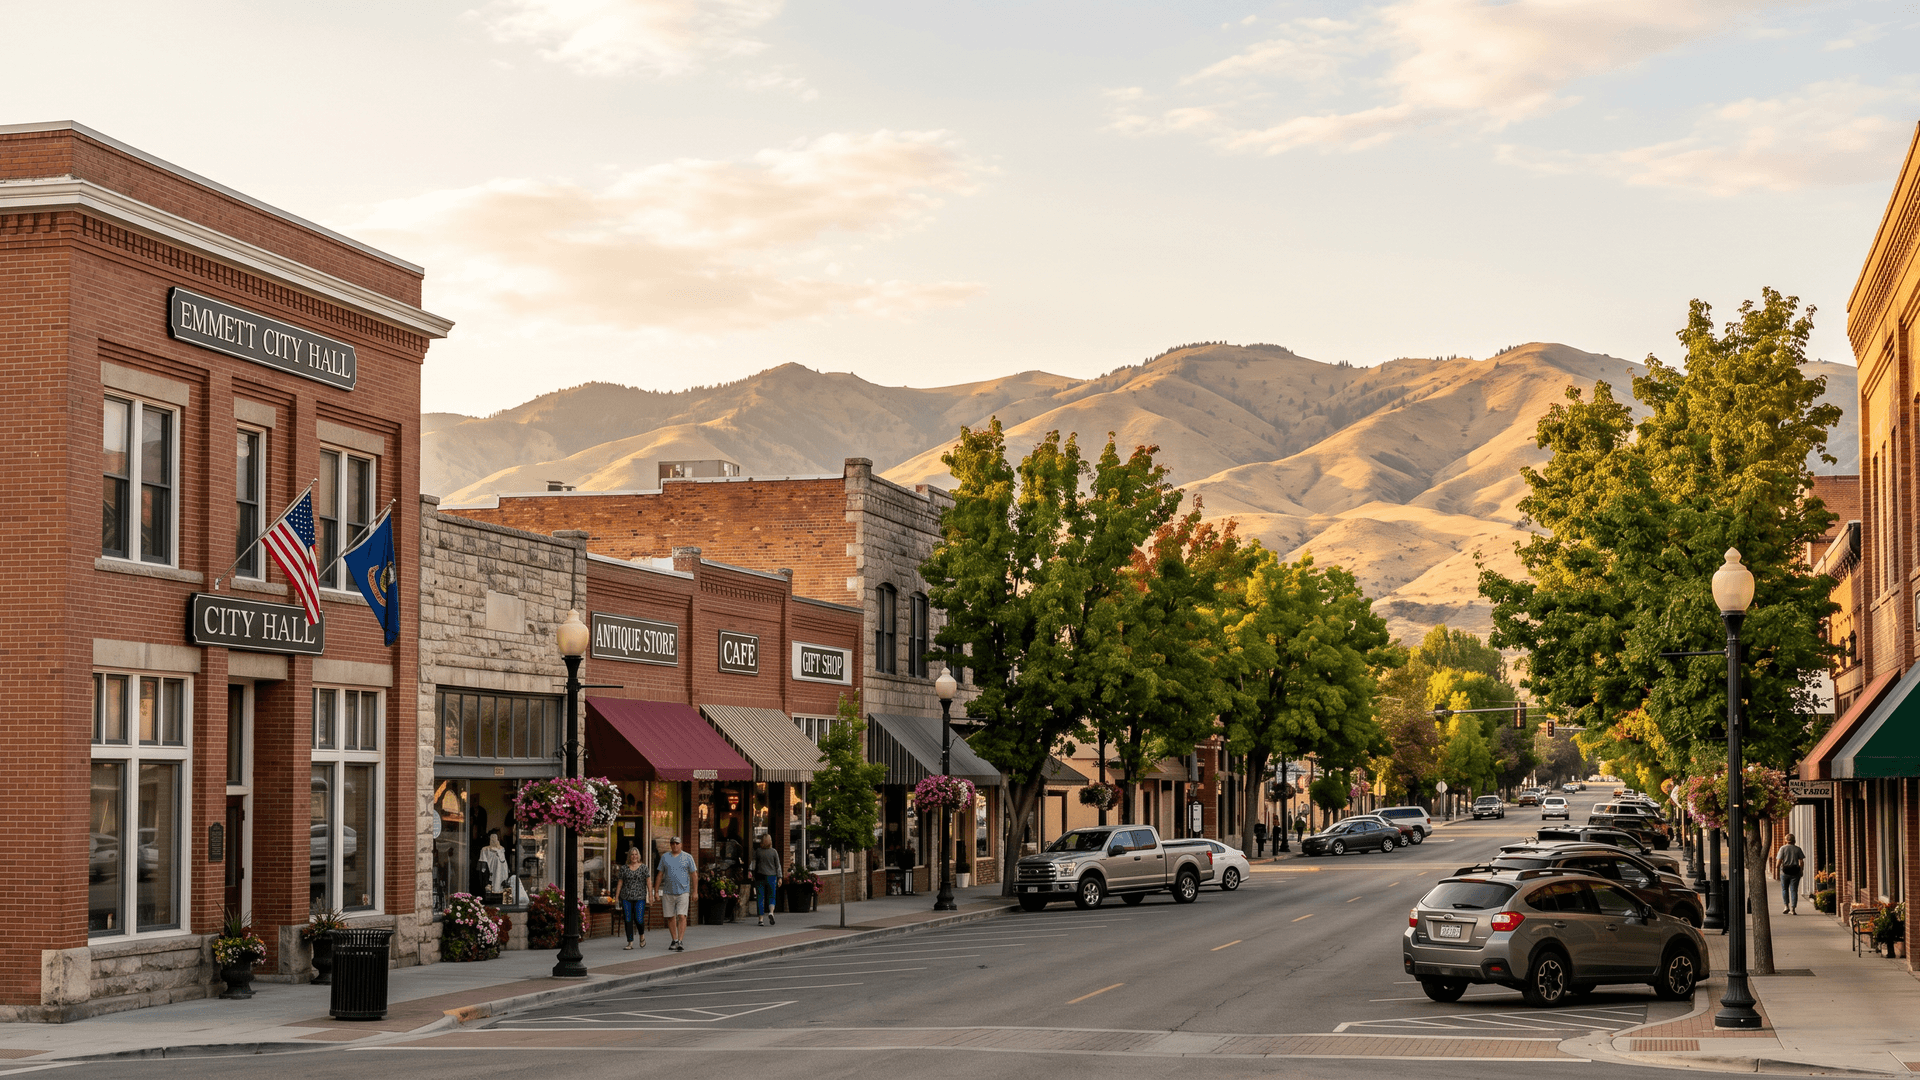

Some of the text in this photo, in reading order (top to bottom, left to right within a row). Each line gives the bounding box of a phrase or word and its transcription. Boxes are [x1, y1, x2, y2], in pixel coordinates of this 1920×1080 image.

[180, 301, 351, 379] EMMETT CITY HALL
[204, 605, 316, 644] CITY HALL
[596, 623, 676, 656] ANTIQUE STORE
[723, 638, 756, 667] CAFÉ
[802, 651, 843, 676] GIFT SHOP
